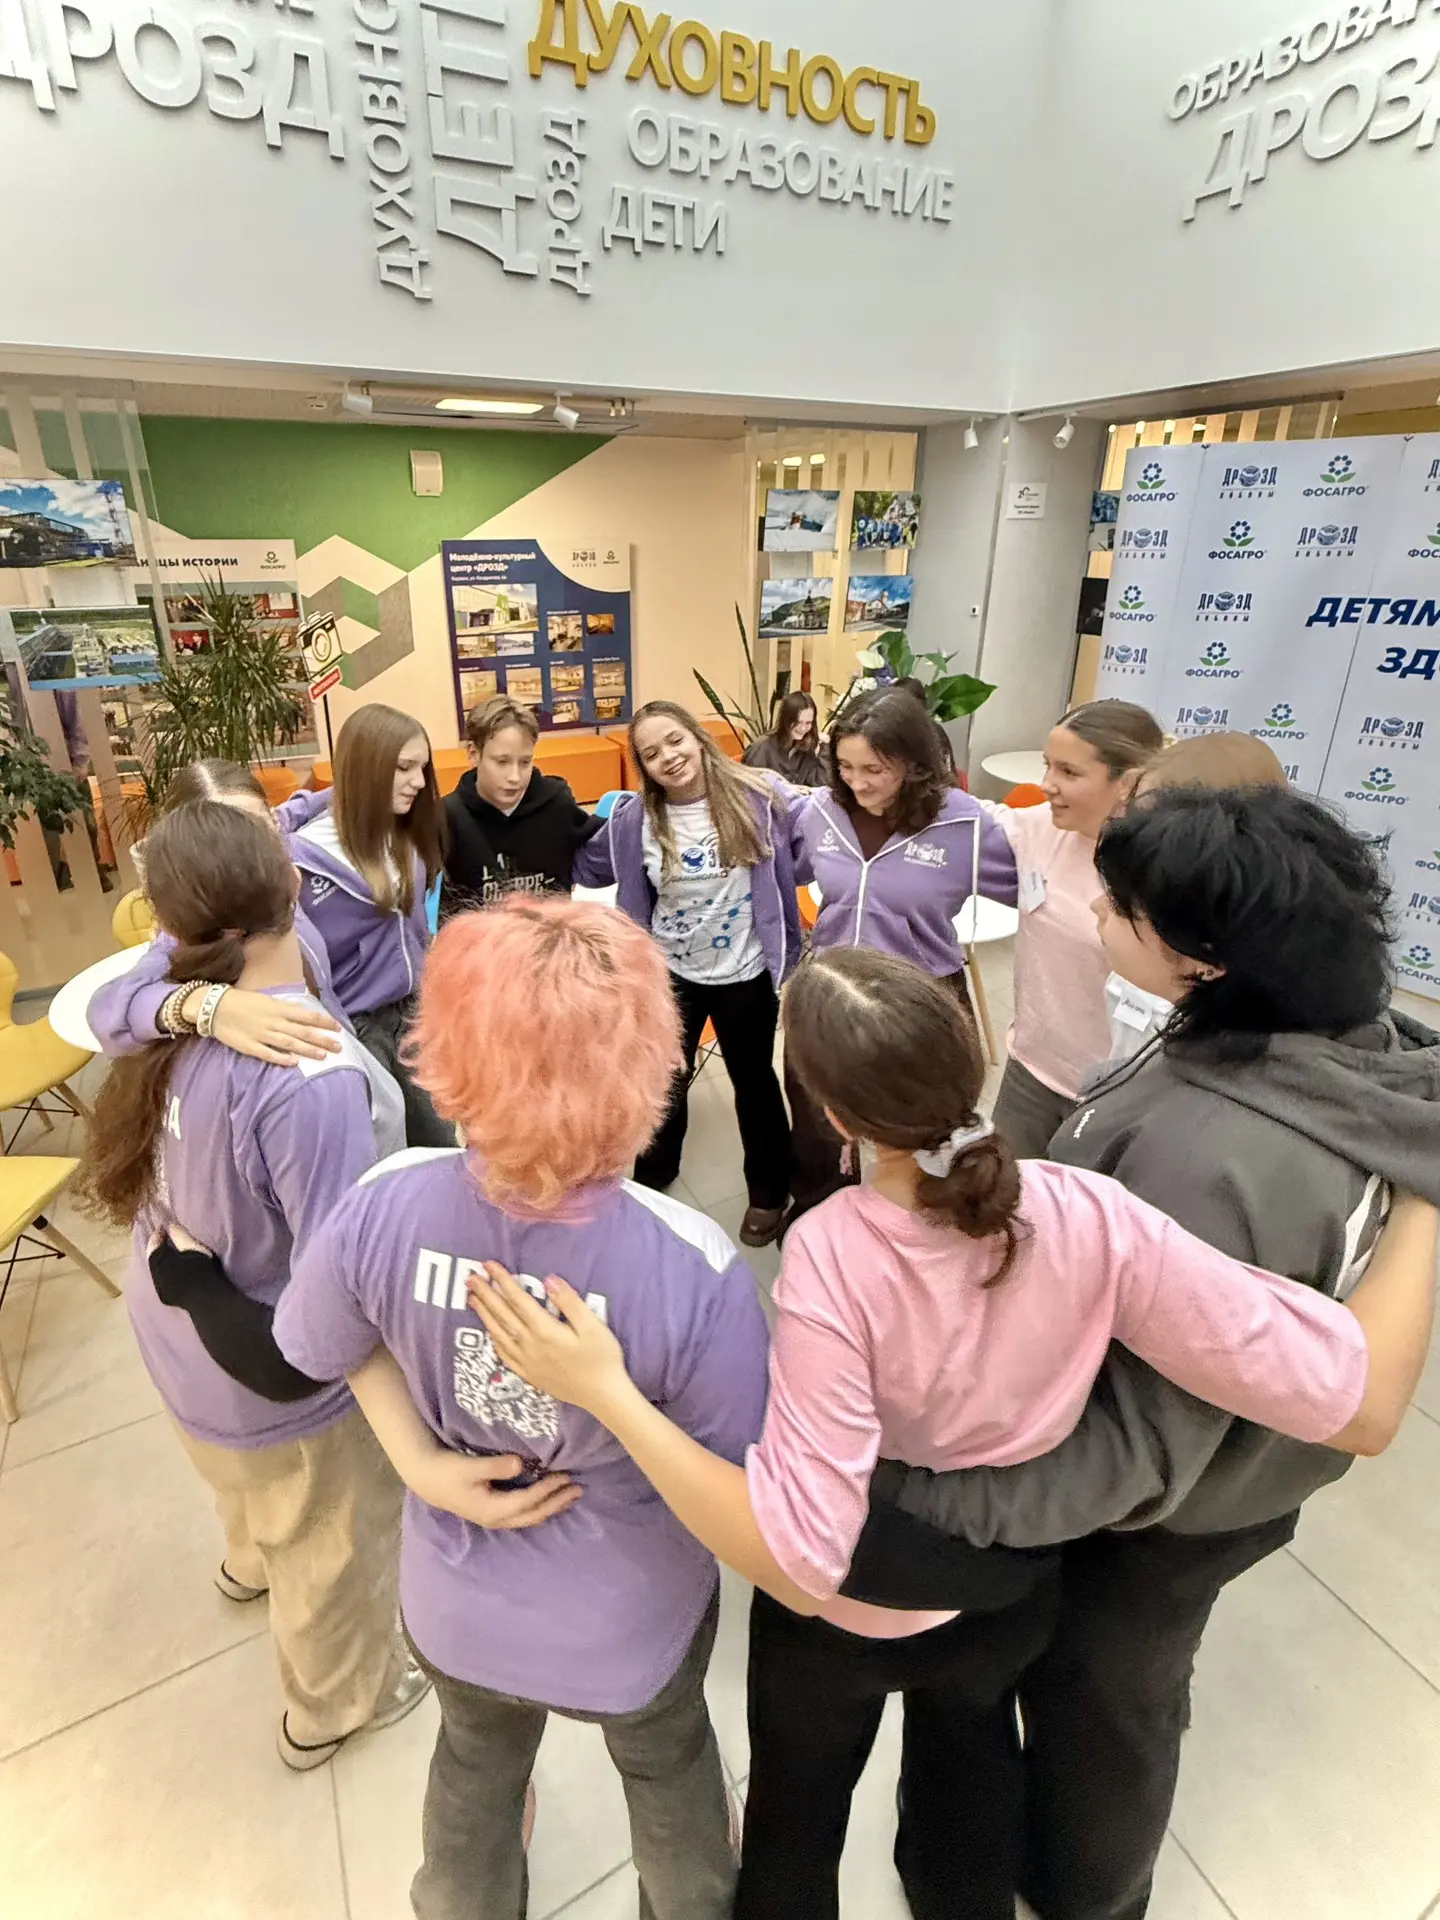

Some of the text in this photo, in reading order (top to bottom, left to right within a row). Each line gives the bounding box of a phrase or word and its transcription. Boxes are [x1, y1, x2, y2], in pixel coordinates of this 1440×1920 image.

[528, 0, 937, 145] ДУХОВНОСТЬ
[420, 0, 538, 276] ДЕТ
[627, 106, 957, 222] ОБРАЗОВАНИЕ
[541, 108, 592, 296] ДРОЗД
[601, 185, 728, 254] ДЕТИ
[1126, 492, 1176, 502] ФОСАГРО
[1302, 486, 1366, 497] ФОСАГРО
[1208, 550, 1264, 559] ФОСАГРО
[182, 558, 238, 567] ИСТОРИИ
[1109, 612, 1154, 622] ФОСАГРО
[1305, 597, 1440, 627] ДЕТЯМ
[1185, 668, 1240, 678] ФОСАГРО
[1249, 729, 1305, 740] ФОСАГРО
[1344, 791, 1406, 805] ФОСАГРО
[1394, 966, 1440, 986] ОСАГРО
